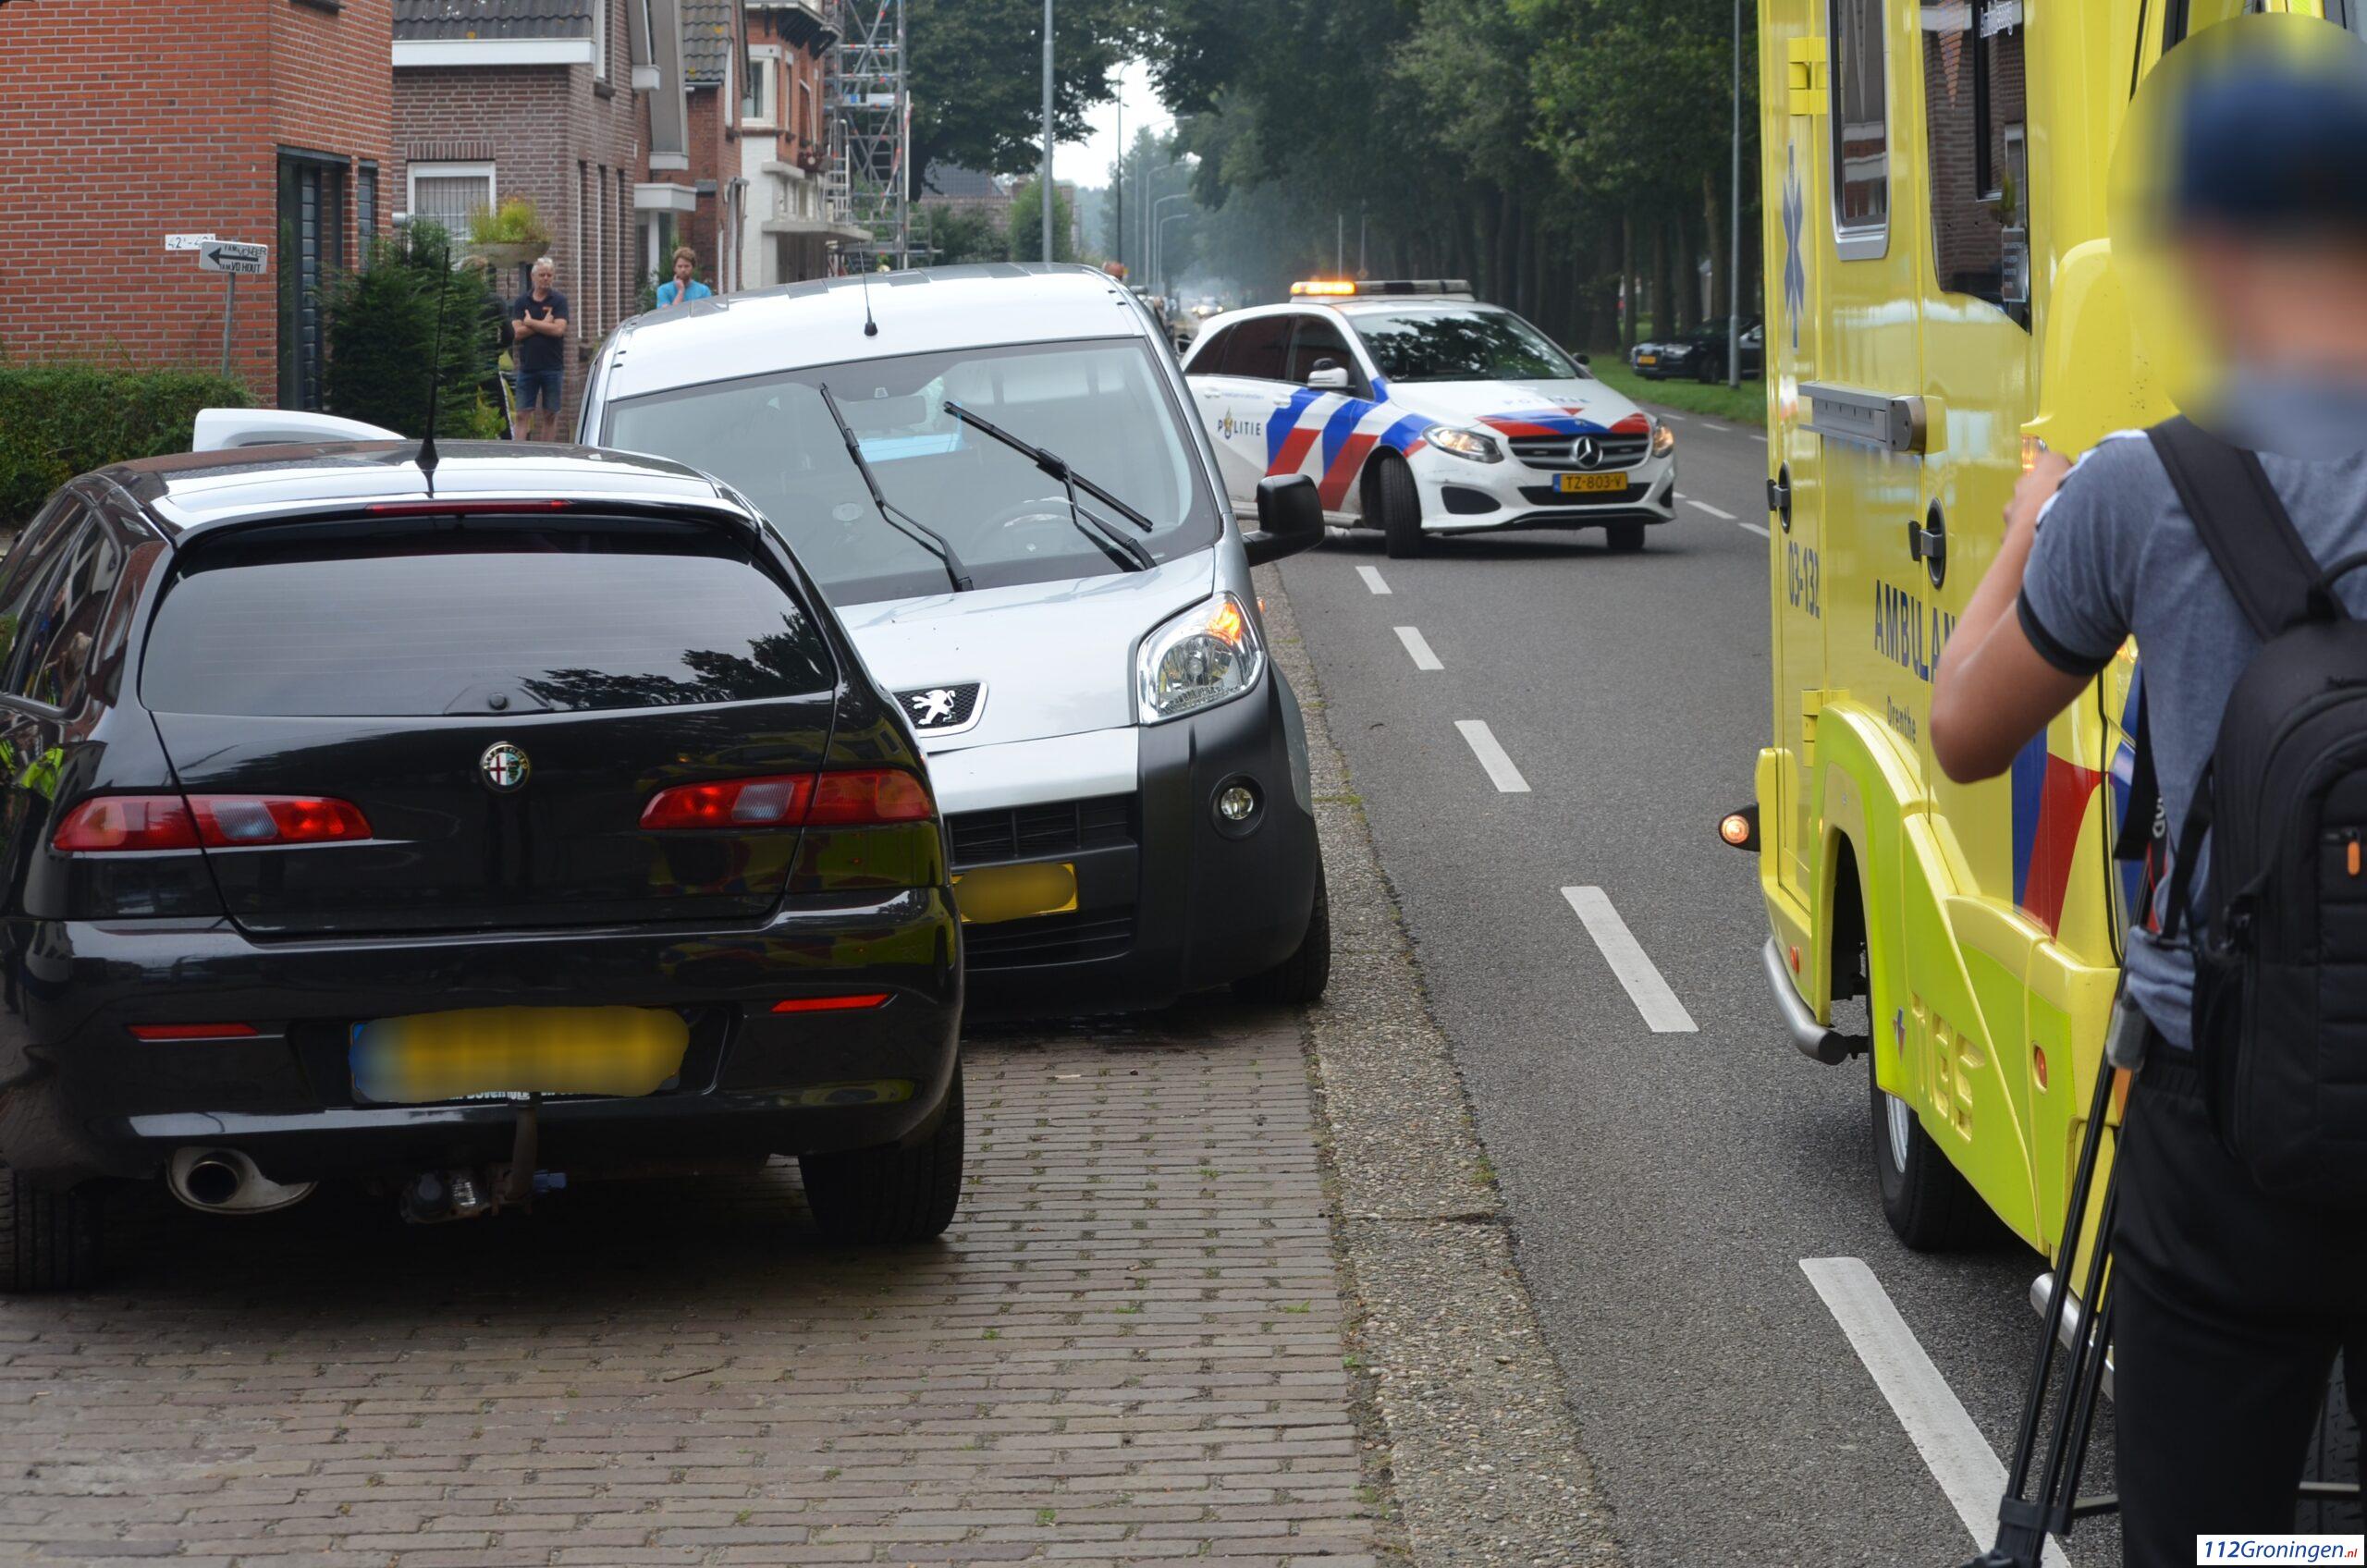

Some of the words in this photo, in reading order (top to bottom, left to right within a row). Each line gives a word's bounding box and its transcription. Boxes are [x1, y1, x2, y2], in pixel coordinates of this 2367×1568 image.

[1217, 418, 1261, 440] POLITIE
[1565, 474, 1623, 490] TZ-803-V
[1788, 539, 1821, 619] 03-132
[1886, 695, 1917, 743] Drenthe
